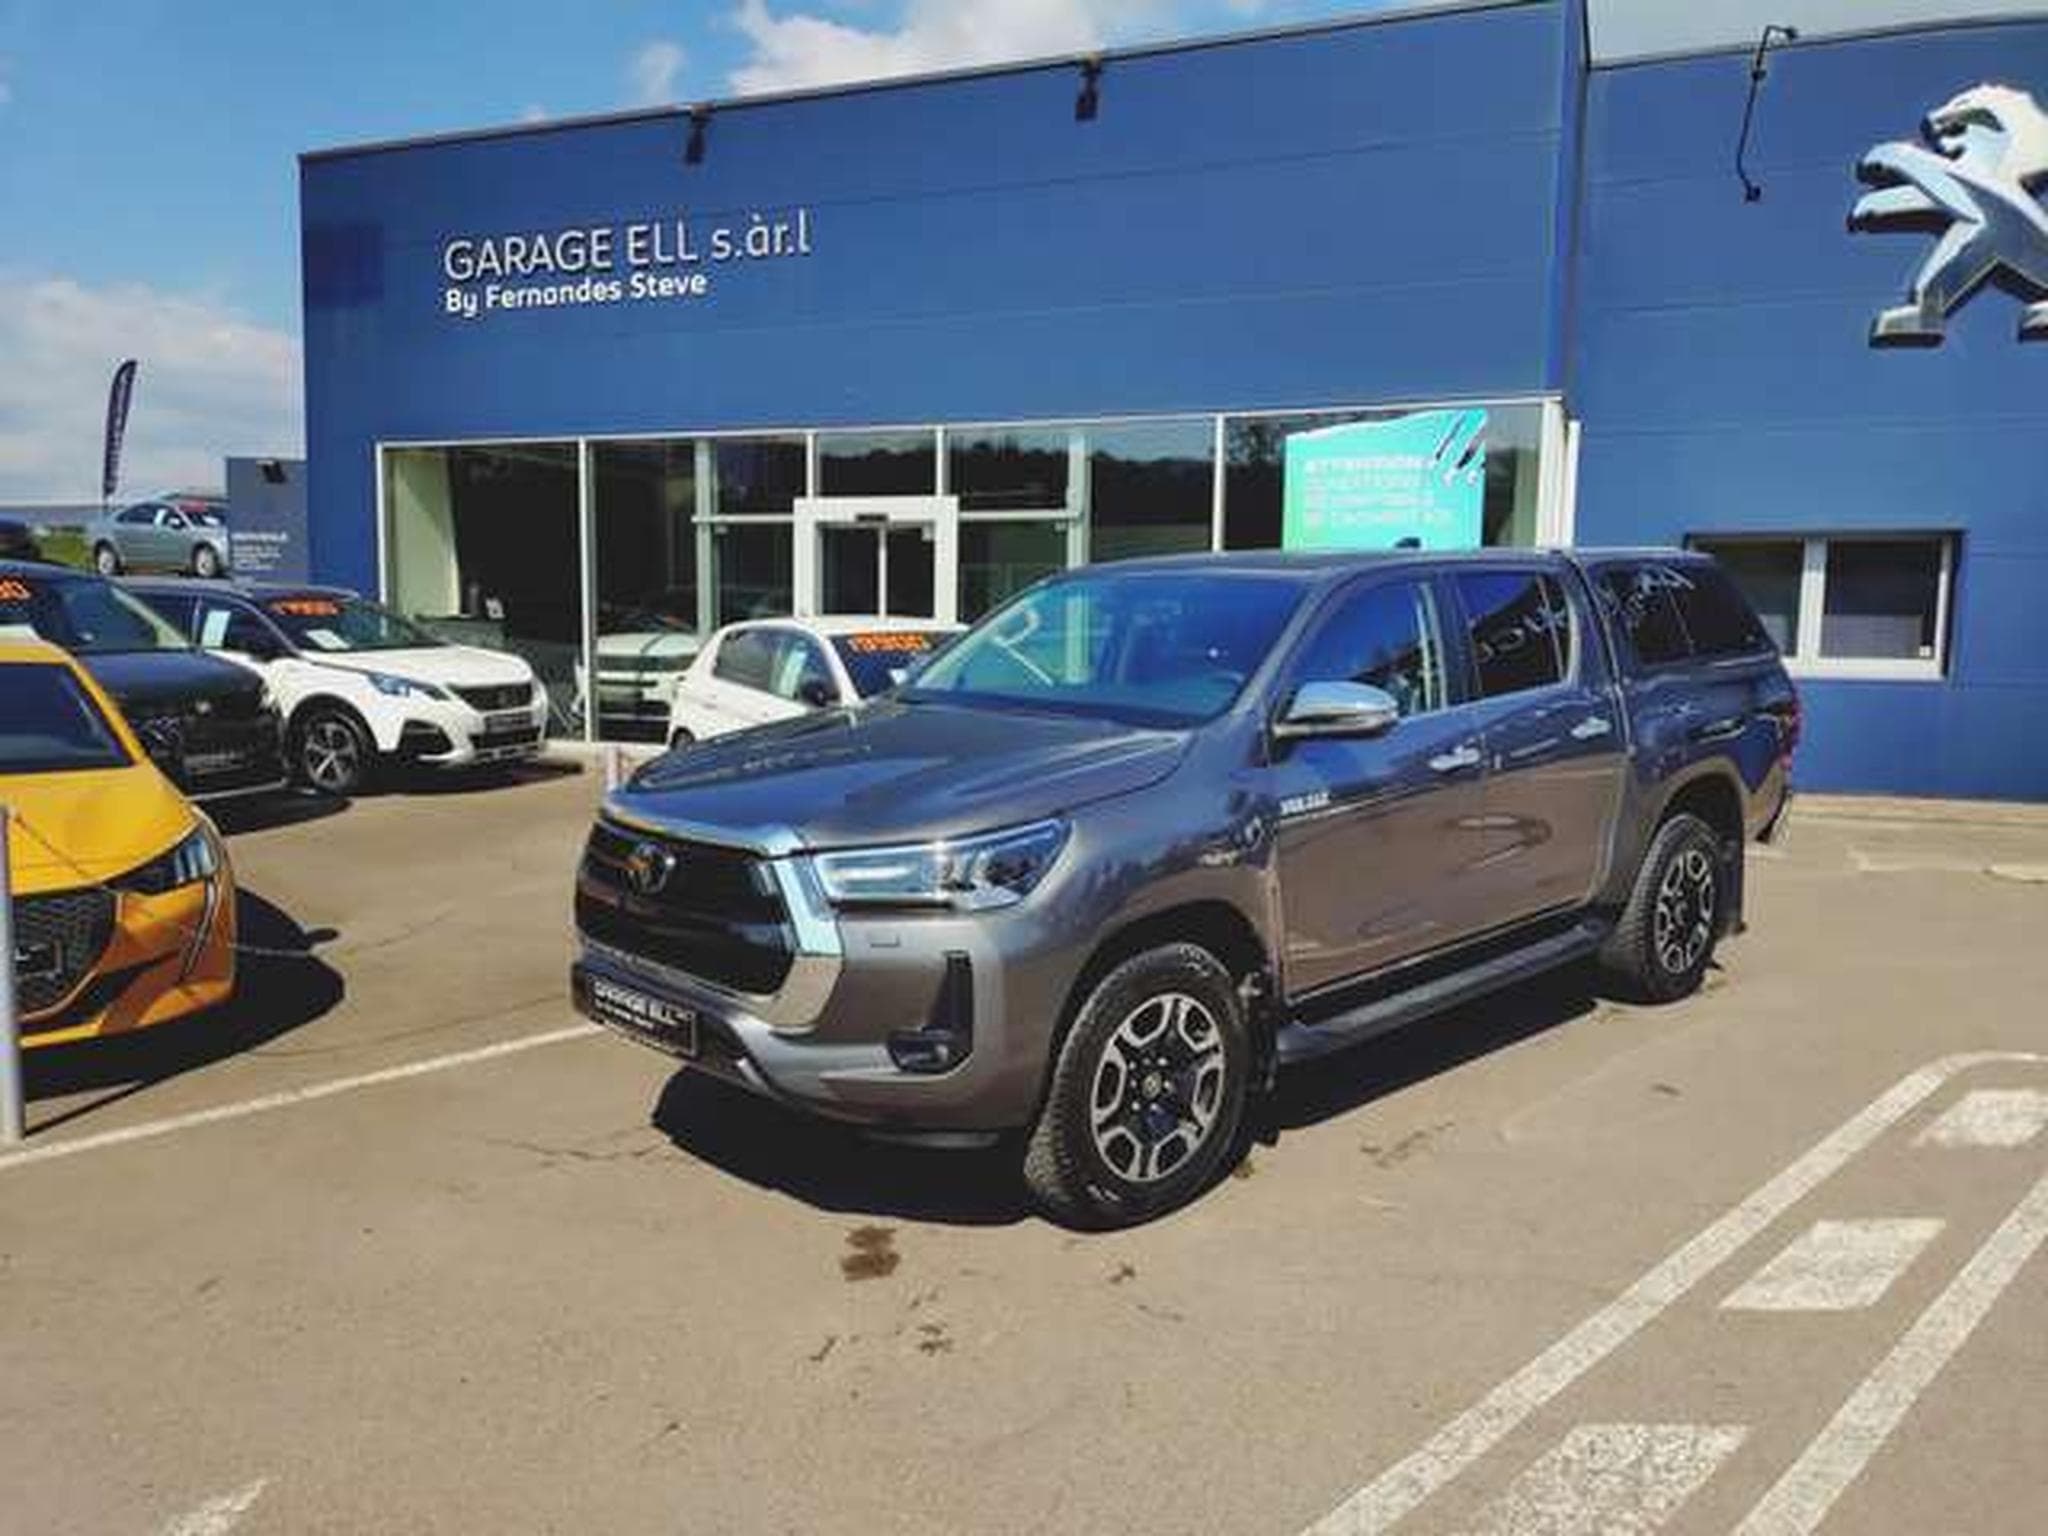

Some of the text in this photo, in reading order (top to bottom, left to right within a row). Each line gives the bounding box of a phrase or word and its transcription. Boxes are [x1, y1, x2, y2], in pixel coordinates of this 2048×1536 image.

[443, 227, 613, 281] GARAGE
[626, 218, 698, 265] ELL
[445, 271, 707, 319] By Fernandes Steve
